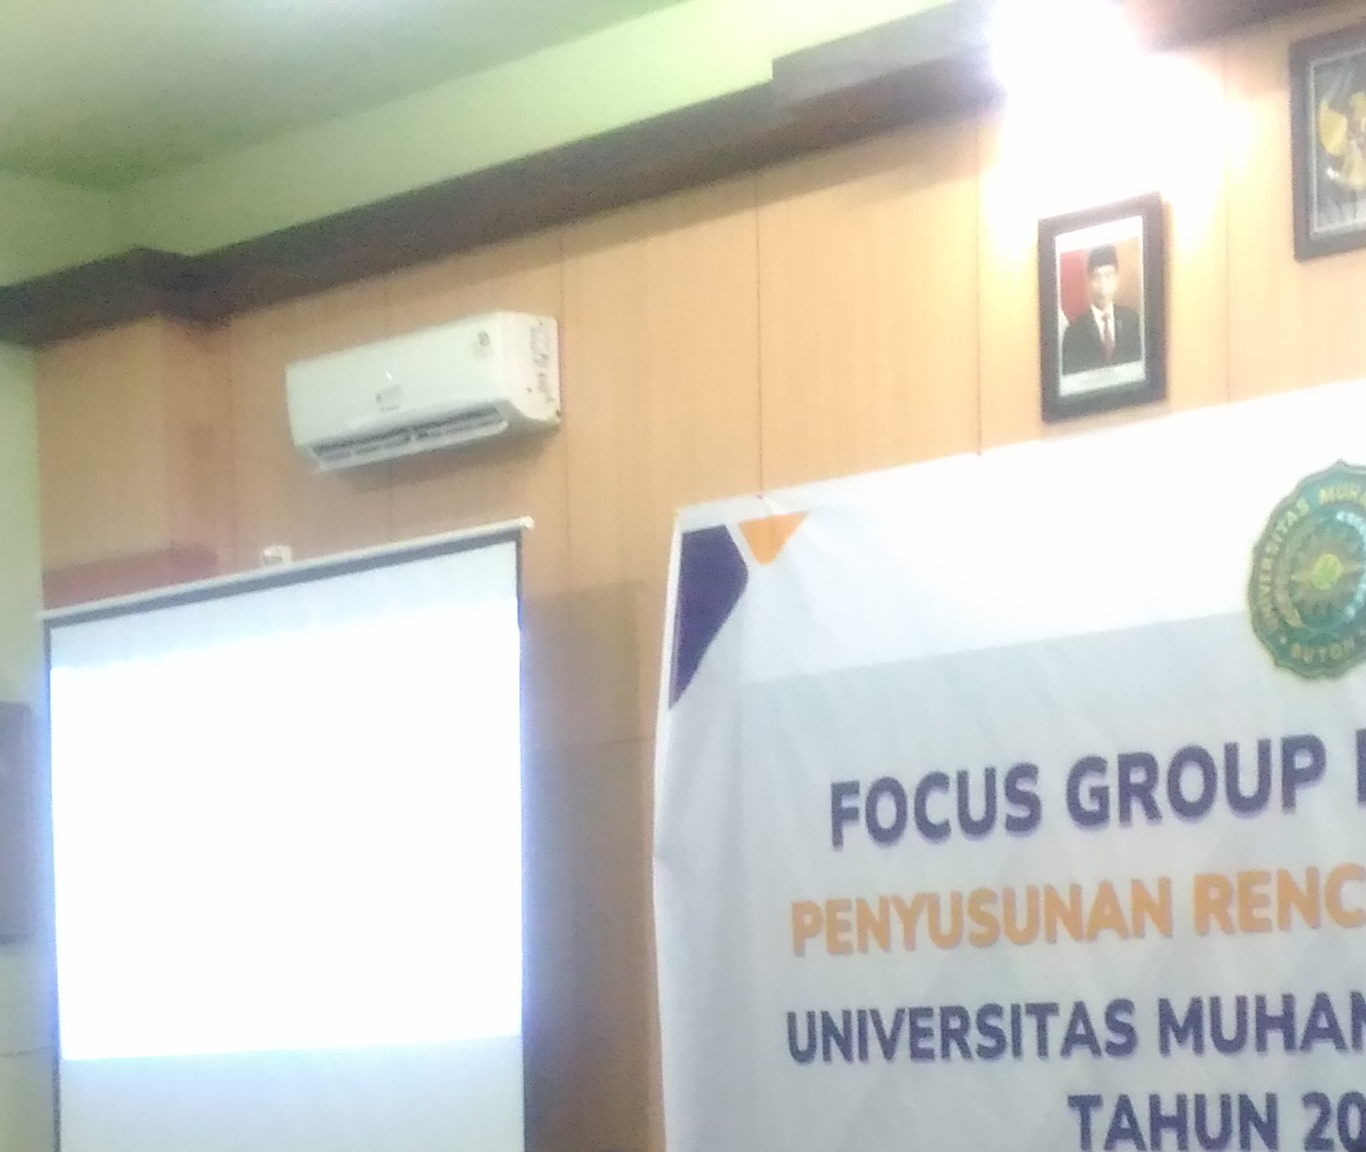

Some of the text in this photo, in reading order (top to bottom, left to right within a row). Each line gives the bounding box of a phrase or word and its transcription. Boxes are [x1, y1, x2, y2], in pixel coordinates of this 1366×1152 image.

[829, 761, 1043, 851] FOCUS
[1066, 733, 1327, 831] GROUP
[791, 877, 1173, 957] PENYUSUNAN
[786, 998, 1136, 1064] UNIVERSITAS
